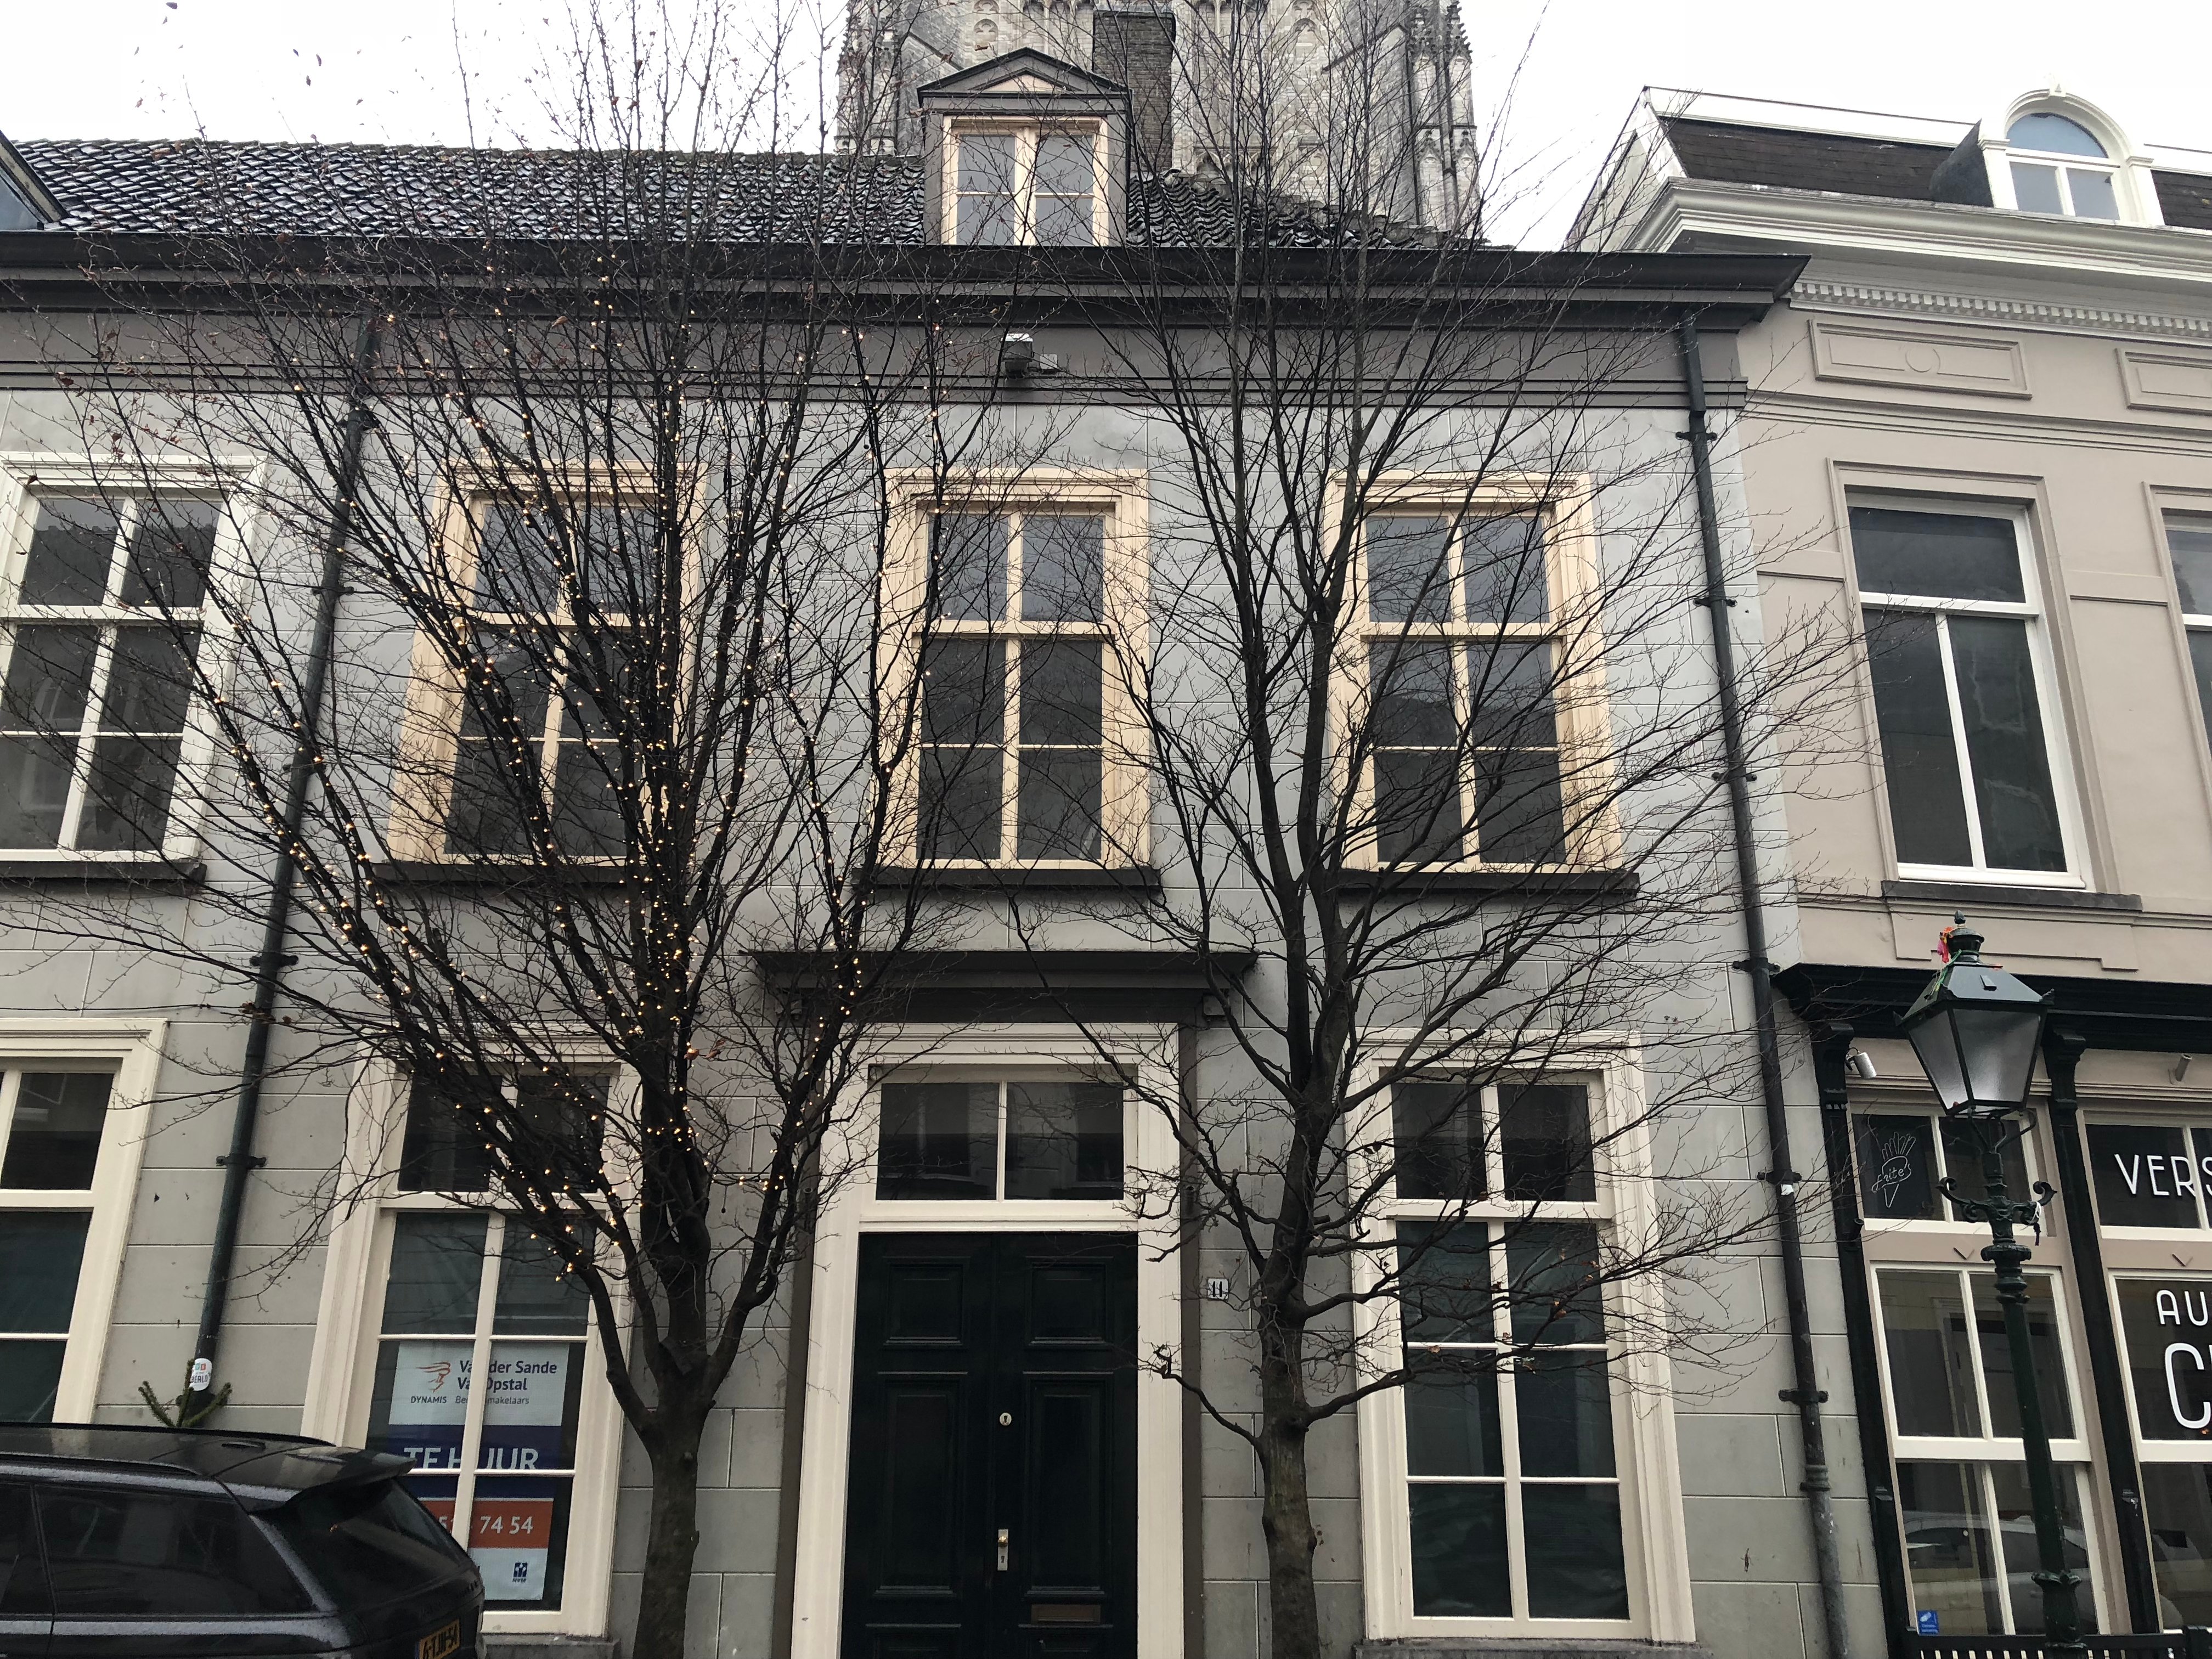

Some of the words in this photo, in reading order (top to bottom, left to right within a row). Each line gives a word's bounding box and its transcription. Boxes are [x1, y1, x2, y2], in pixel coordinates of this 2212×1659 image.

[1212, 1280, 1222, 1297] 11
[489, 1360, 512, 1373] der
[515, 1360, 557, 1374] Sande
[486, 1377, 528, 1393] Opstal
[2164, 1342, 2212, 1429] C
[410, 1396, 447, 1404] DYNAMIS
[479, 1515, 504, 1534] 74
[509, 1516, 534, 1534] 54
